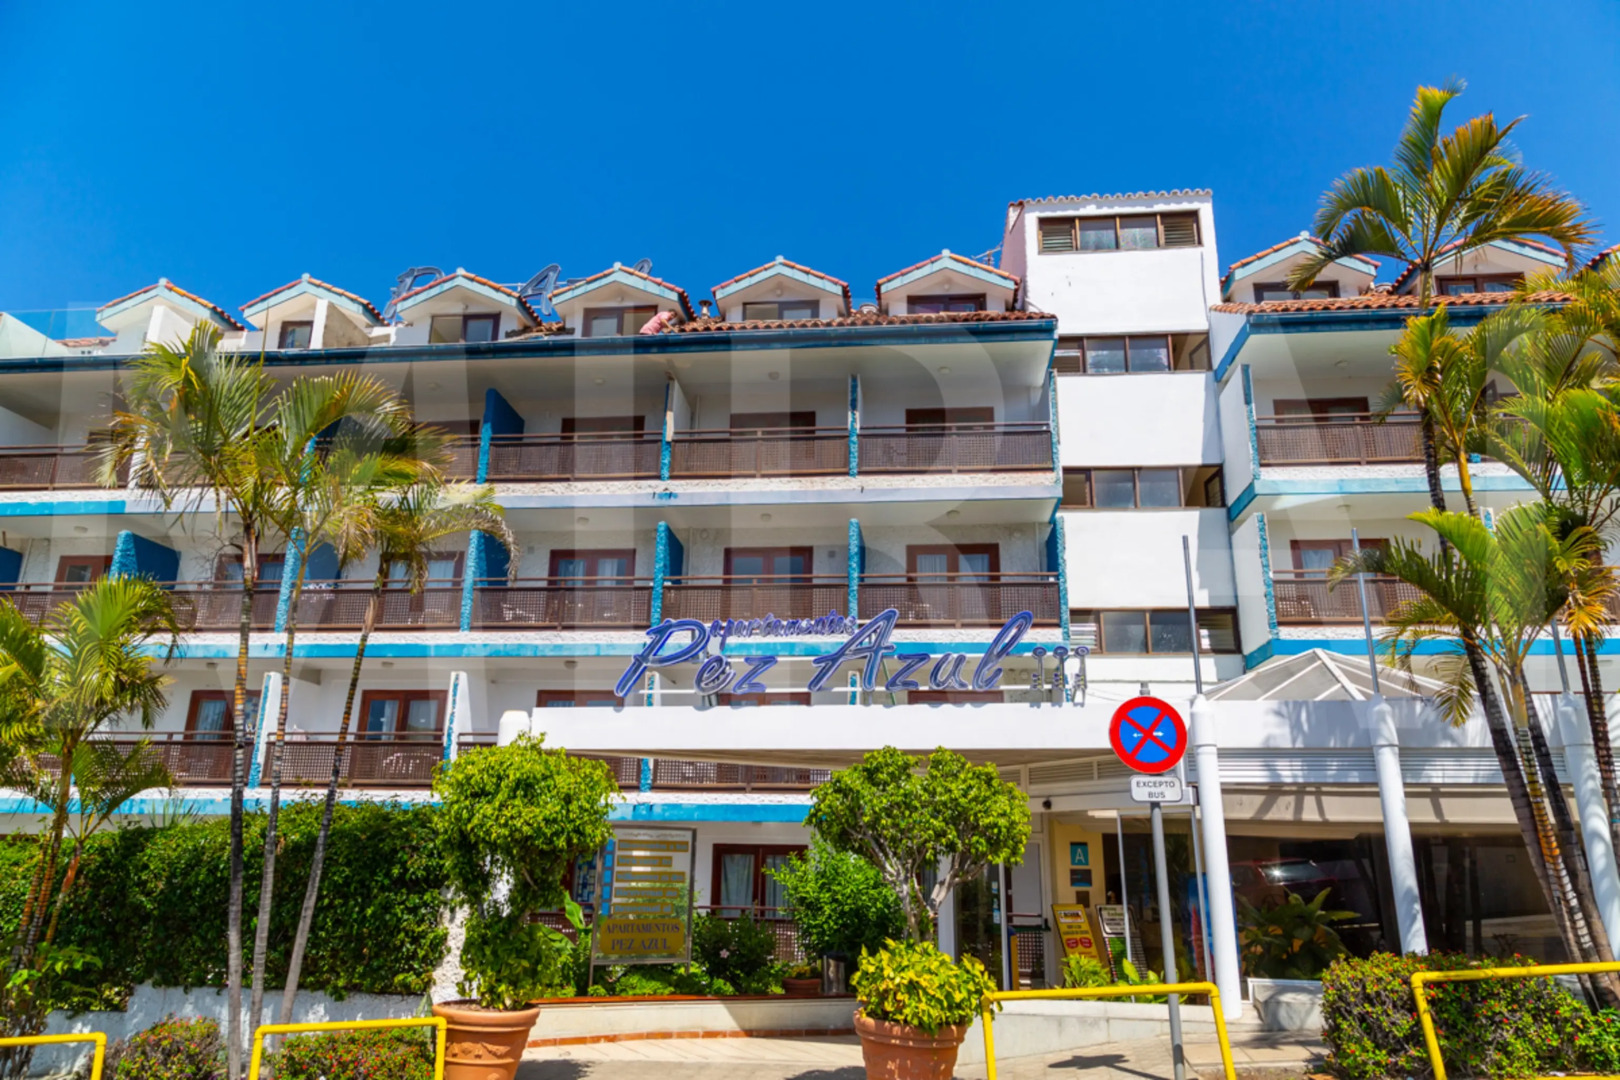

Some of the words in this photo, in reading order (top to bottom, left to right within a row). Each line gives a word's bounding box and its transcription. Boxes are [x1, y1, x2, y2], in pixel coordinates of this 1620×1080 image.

[614, 617, 779, 698] Pez
[807, 607, 1035, 694] Azul
[1136, 780, 1176, 788] EXCEPTO
[1148, 791, 1166, 799] BUS
[1075, 848, 1085, 863] A
[605, 922, 680, 934] APARTAMENTOS
[611, 938, 635, 951] PEZ
[640, 938, 671, 951] AZUL
